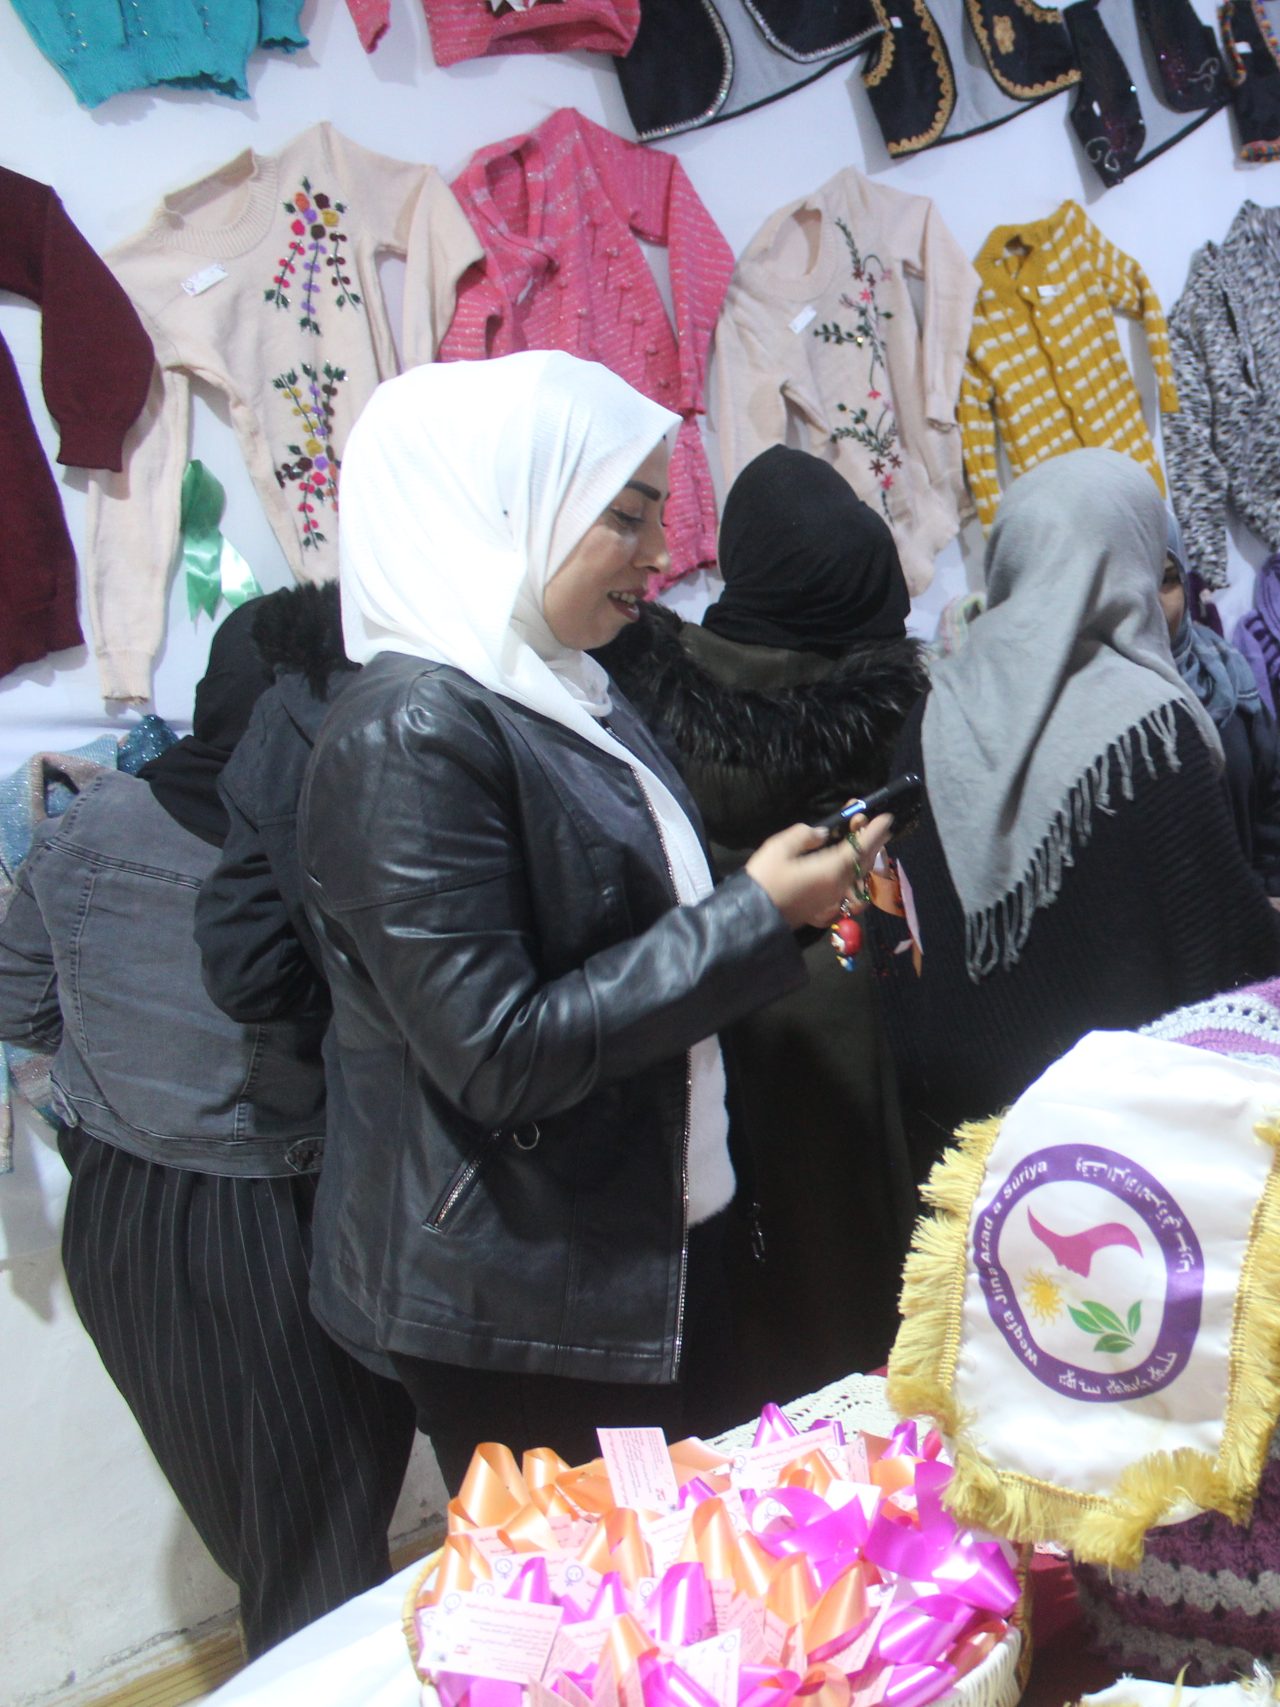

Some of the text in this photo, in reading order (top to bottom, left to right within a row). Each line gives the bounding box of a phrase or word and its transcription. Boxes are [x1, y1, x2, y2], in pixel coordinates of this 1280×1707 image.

[994, 1203, 1002, 1215] a
[1076, 1157, 1108, 1177] وقف
[1135, 1184, 1168, 1221] الحرة
[1161, 1215, 1183, 1229] في
[1175, 1232, 1195, 1273] سوريا
[980, 1217, 994, 1264] Azad
[988, 1268, 1008, 1304] Jina
[1002, 1309, 1038, 1367] Weqfa
